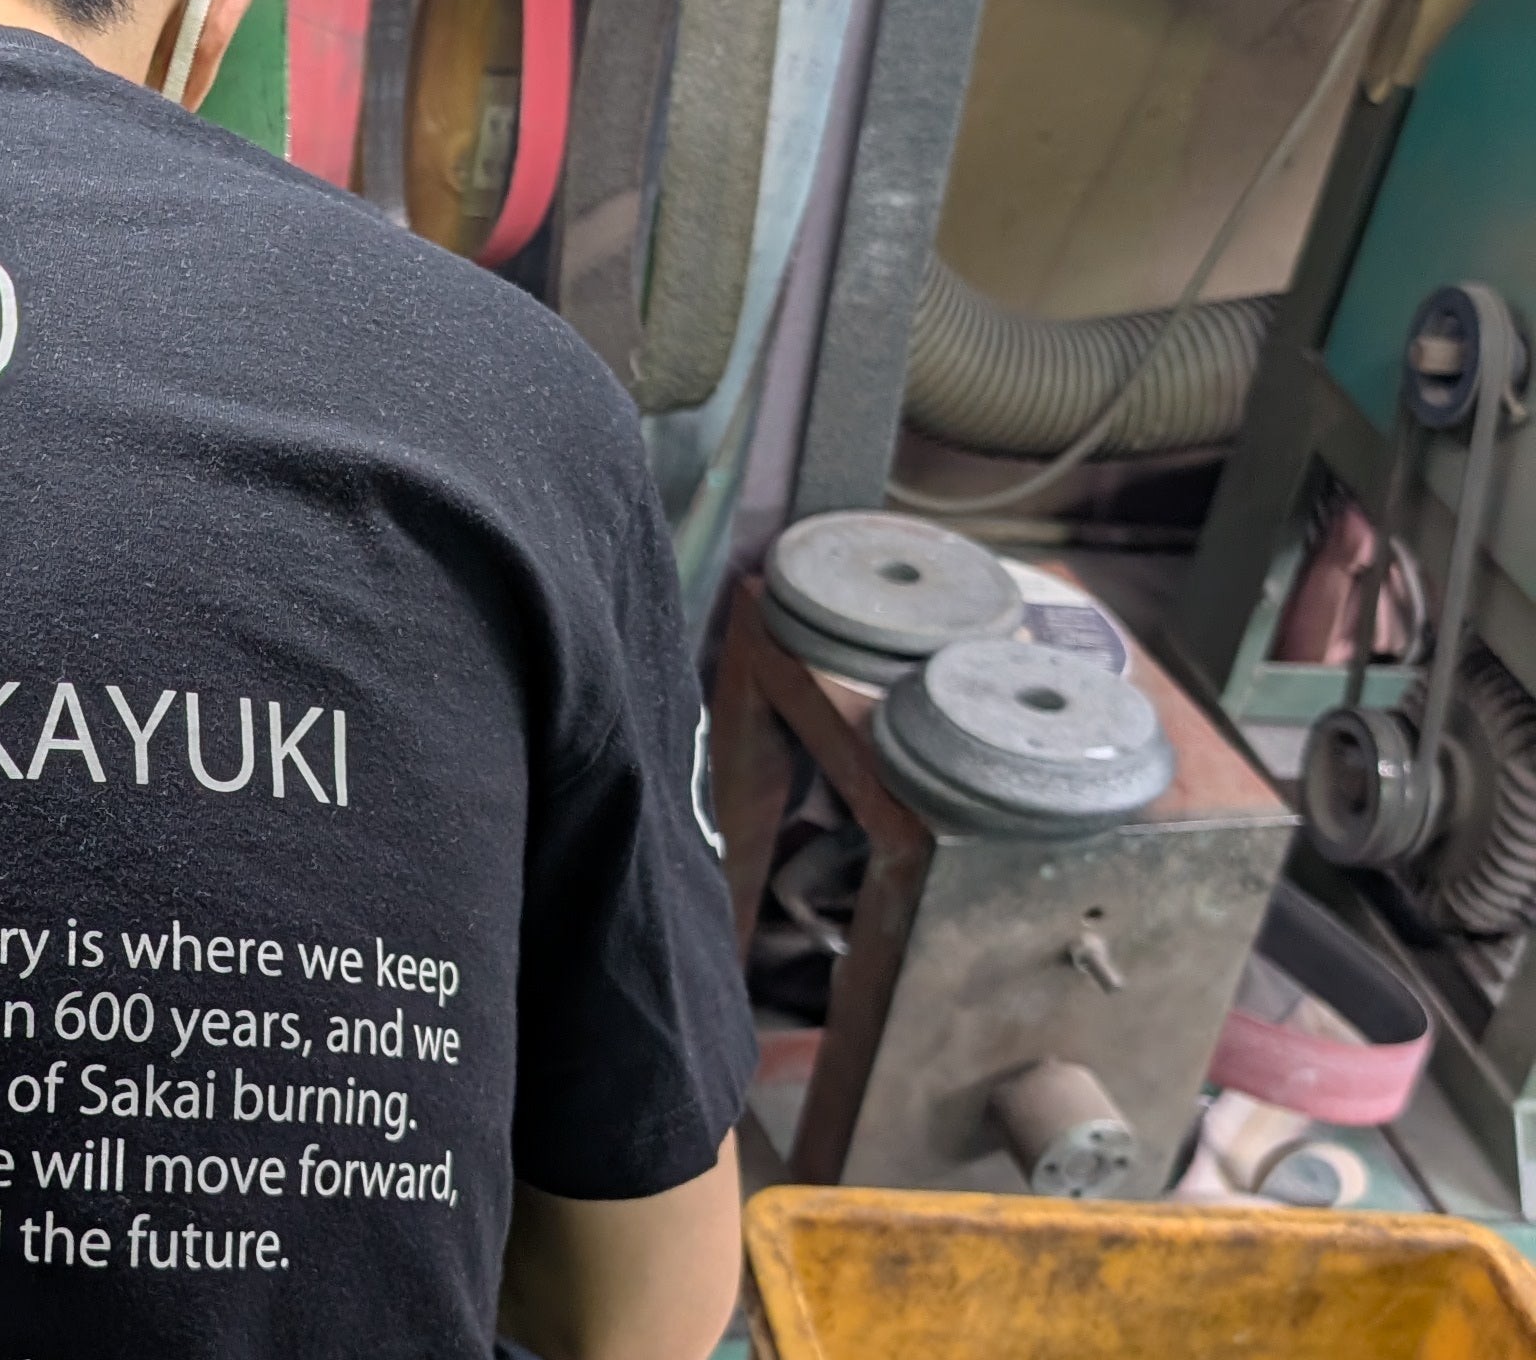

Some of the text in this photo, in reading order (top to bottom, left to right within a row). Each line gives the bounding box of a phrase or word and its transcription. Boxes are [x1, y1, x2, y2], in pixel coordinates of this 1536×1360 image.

[67, 917, 105, 968] is
[120, 919, 284, 977] where
[297, 943, 364, 984] we
[375, 936, 460, 1008] keep
[54, 990, 155, 1043] 600
[170, 1007, 312, 1059] years,
[326, 1007, 404, 1058] and
[413, 1024, 460, 1065] we
[7, 1060, 68, 1113] of
[79, 1063, 216, 1119] Sakai
[233, 1067, 418, 1142] burning.
[31, 1137, 125, 1192] will
[144, 1154, 286, 1196] move
[298, 1143, 458, 1207] forward,
[19, 1210, 111, 1268] the
[127, 1213, 289, 1270] future.
